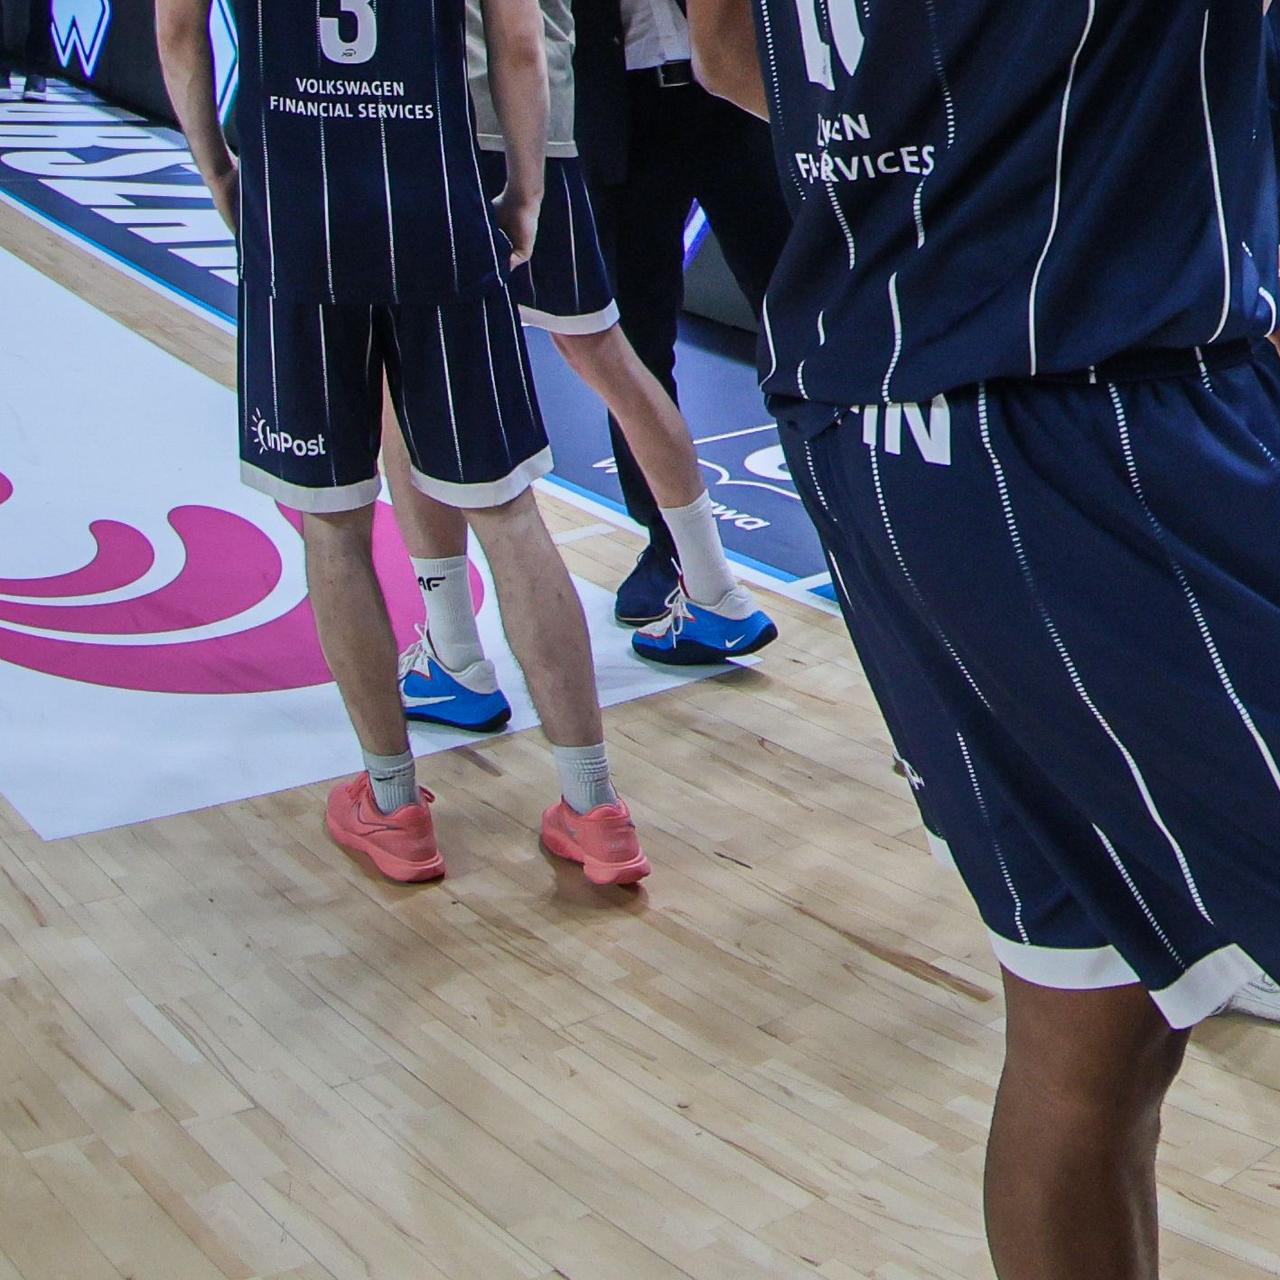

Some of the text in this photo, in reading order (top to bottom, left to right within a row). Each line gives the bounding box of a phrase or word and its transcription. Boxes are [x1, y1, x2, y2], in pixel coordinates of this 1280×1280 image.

[295, 76, 405, 97] VOLKSWAGEN
[269, 95, 434, 120] FINANCIAL SERVICES
[266, 425, 326, 456] InPost
